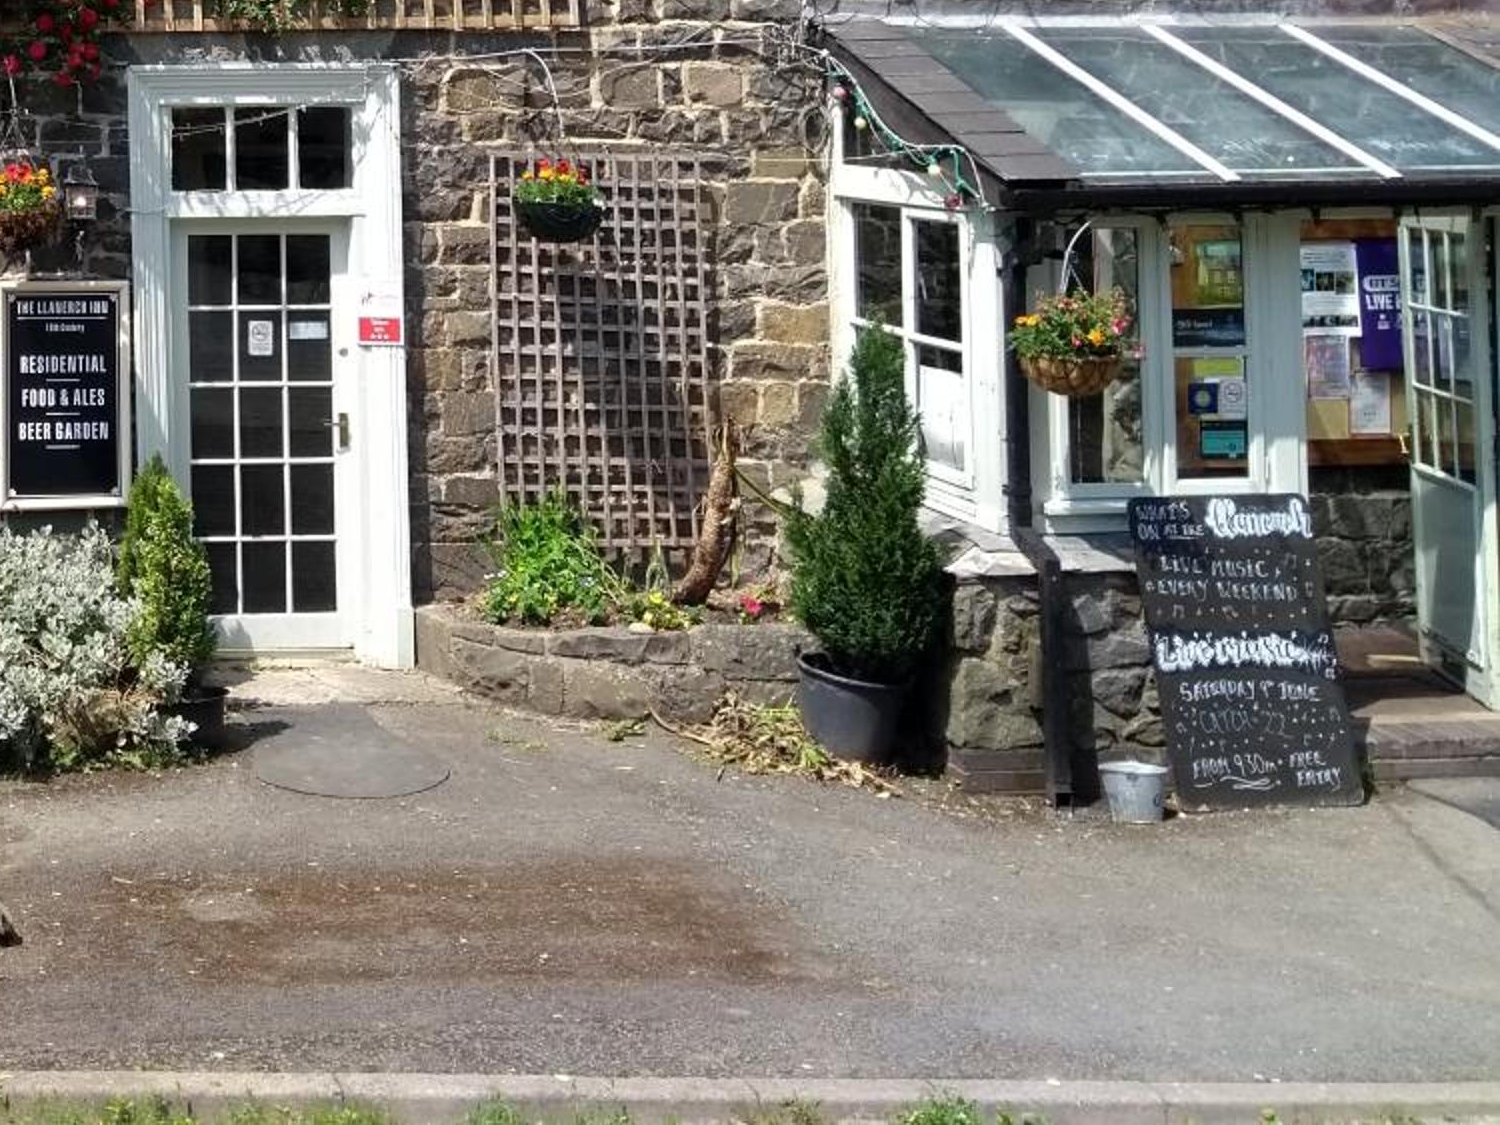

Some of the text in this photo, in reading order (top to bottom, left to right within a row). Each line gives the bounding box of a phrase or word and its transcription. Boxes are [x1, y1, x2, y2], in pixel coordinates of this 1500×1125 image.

[16, 300, 109, 315] THE LLANERCH INN
[20, 355, 107, 374] RESIDENTIAL
[21, 388, 105, 408] FOOD & ALES
[18, 421, 109, 441] BEER GARDEN
[1216, 581, 1298, 602] WEEKEND
[1179, 681, 1256, 702] SATURDAY
[1296, 769, 1341, 791] ENTRY
